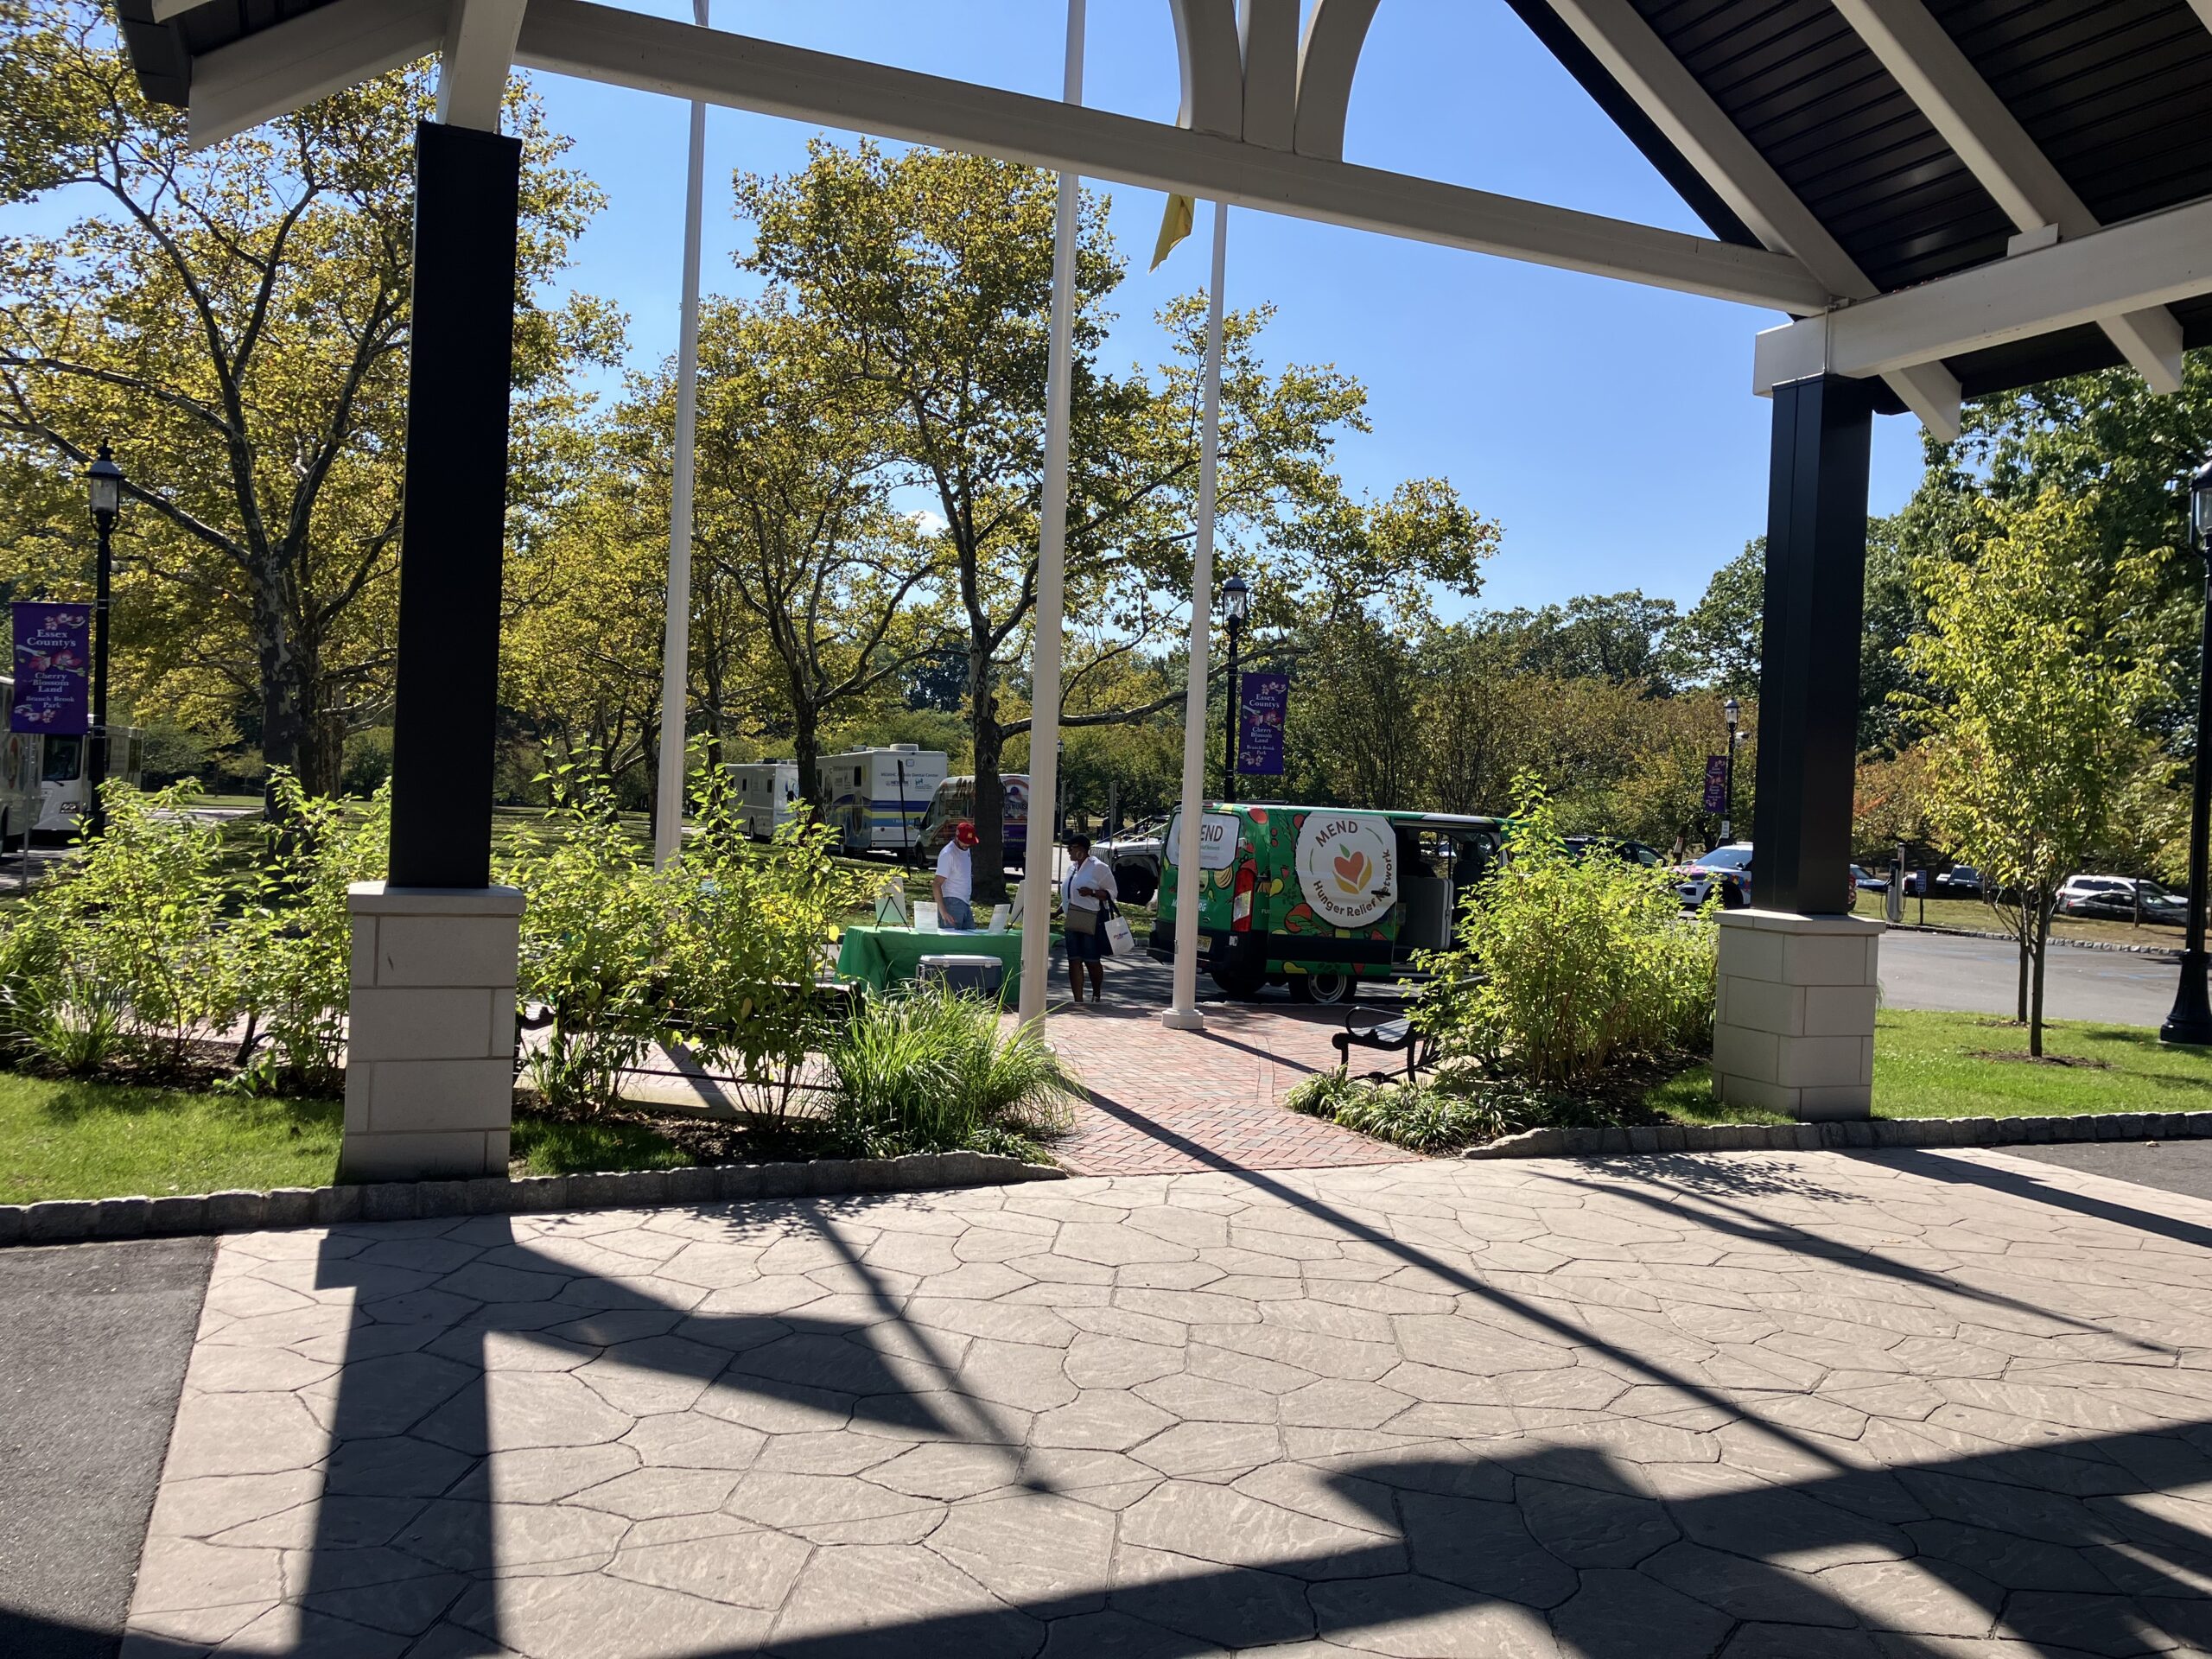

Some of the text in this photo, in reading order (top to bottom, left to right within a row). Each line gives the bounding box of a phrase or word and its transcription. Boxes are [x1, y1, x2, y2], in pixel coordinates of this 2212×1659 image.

[36, 629, 67, 638] Essex
[27, 638, 76, 649] County's
[35, 672, 67, 681] Cherry
[1200, 824, 1224, 842] END
[1315, 821, 1358, 848] MEND
[1313, 880, 1344, 915] Hunger
[1347, 898, 1376, 917] Relief
